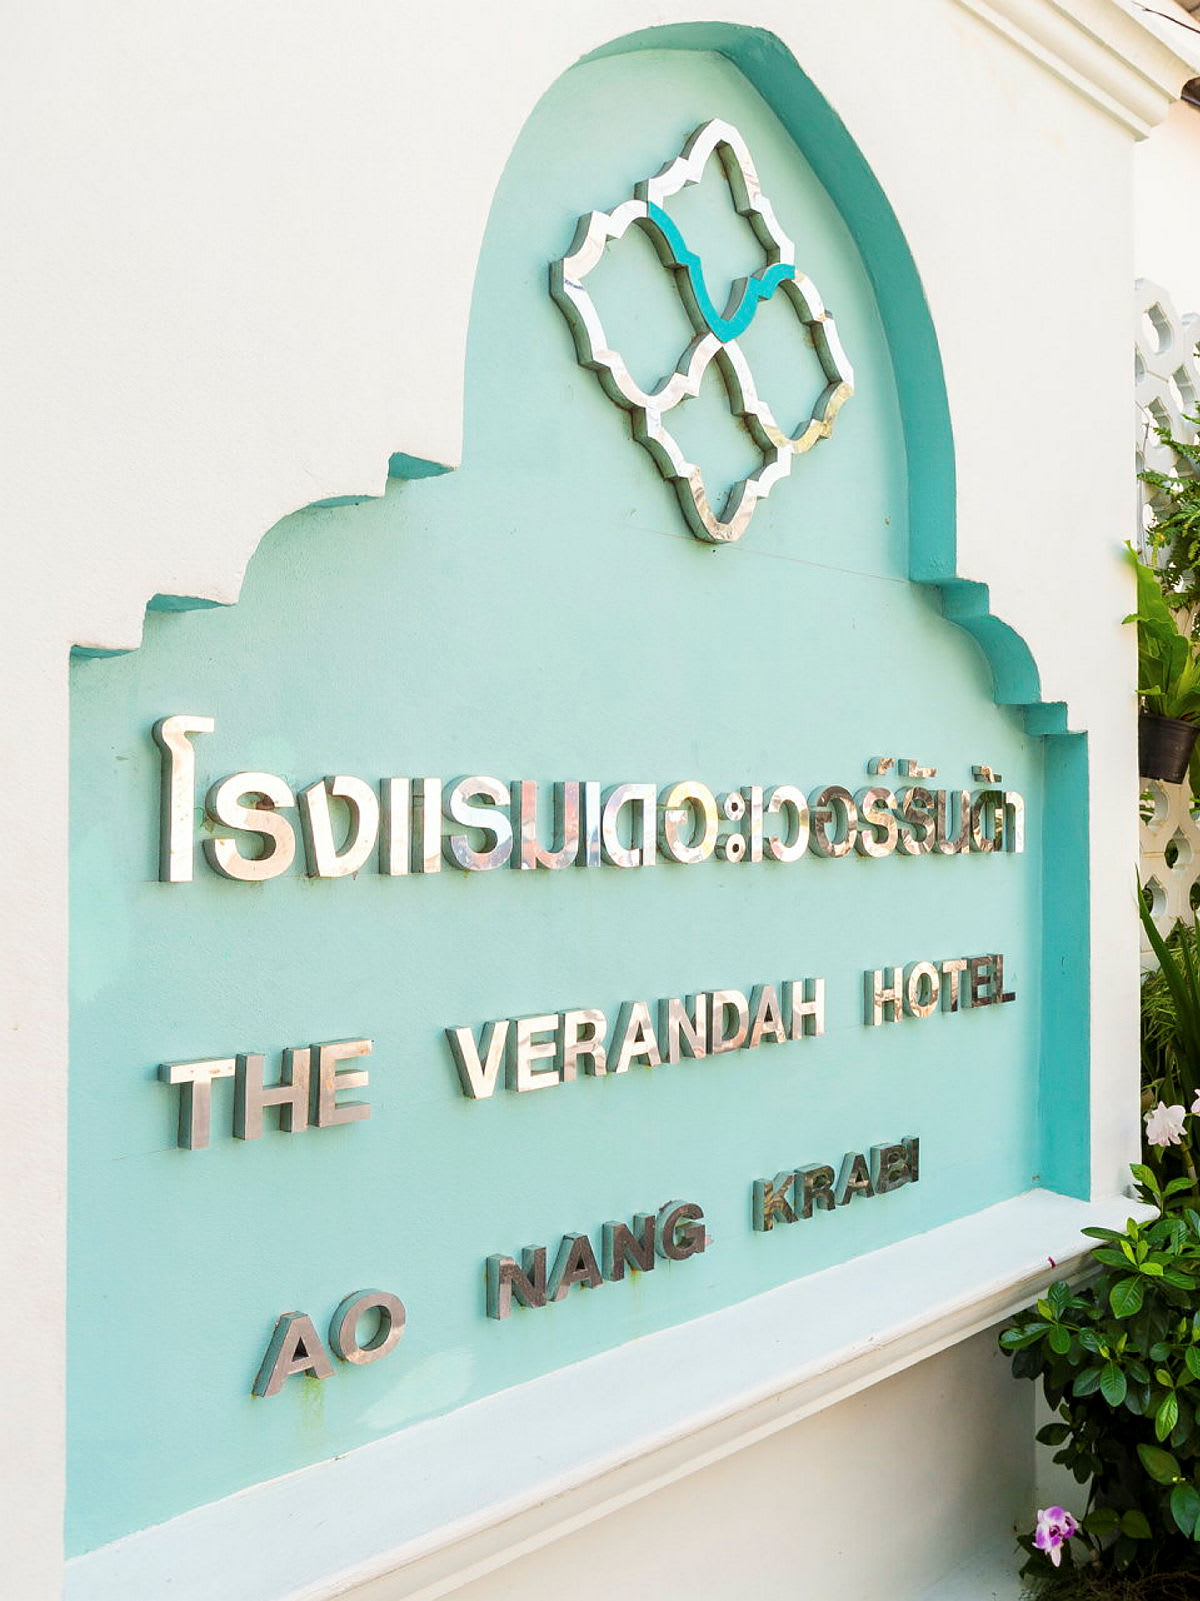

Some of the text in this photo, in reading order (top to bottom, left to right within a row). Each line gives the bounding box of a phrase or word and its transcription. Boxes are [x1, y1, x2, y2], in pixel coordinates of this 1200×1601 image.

[159, 954, 1015, 1150] THE VERANDAH HOTEL
[252, 1136, 919, 1397] AO NANG KRABI
